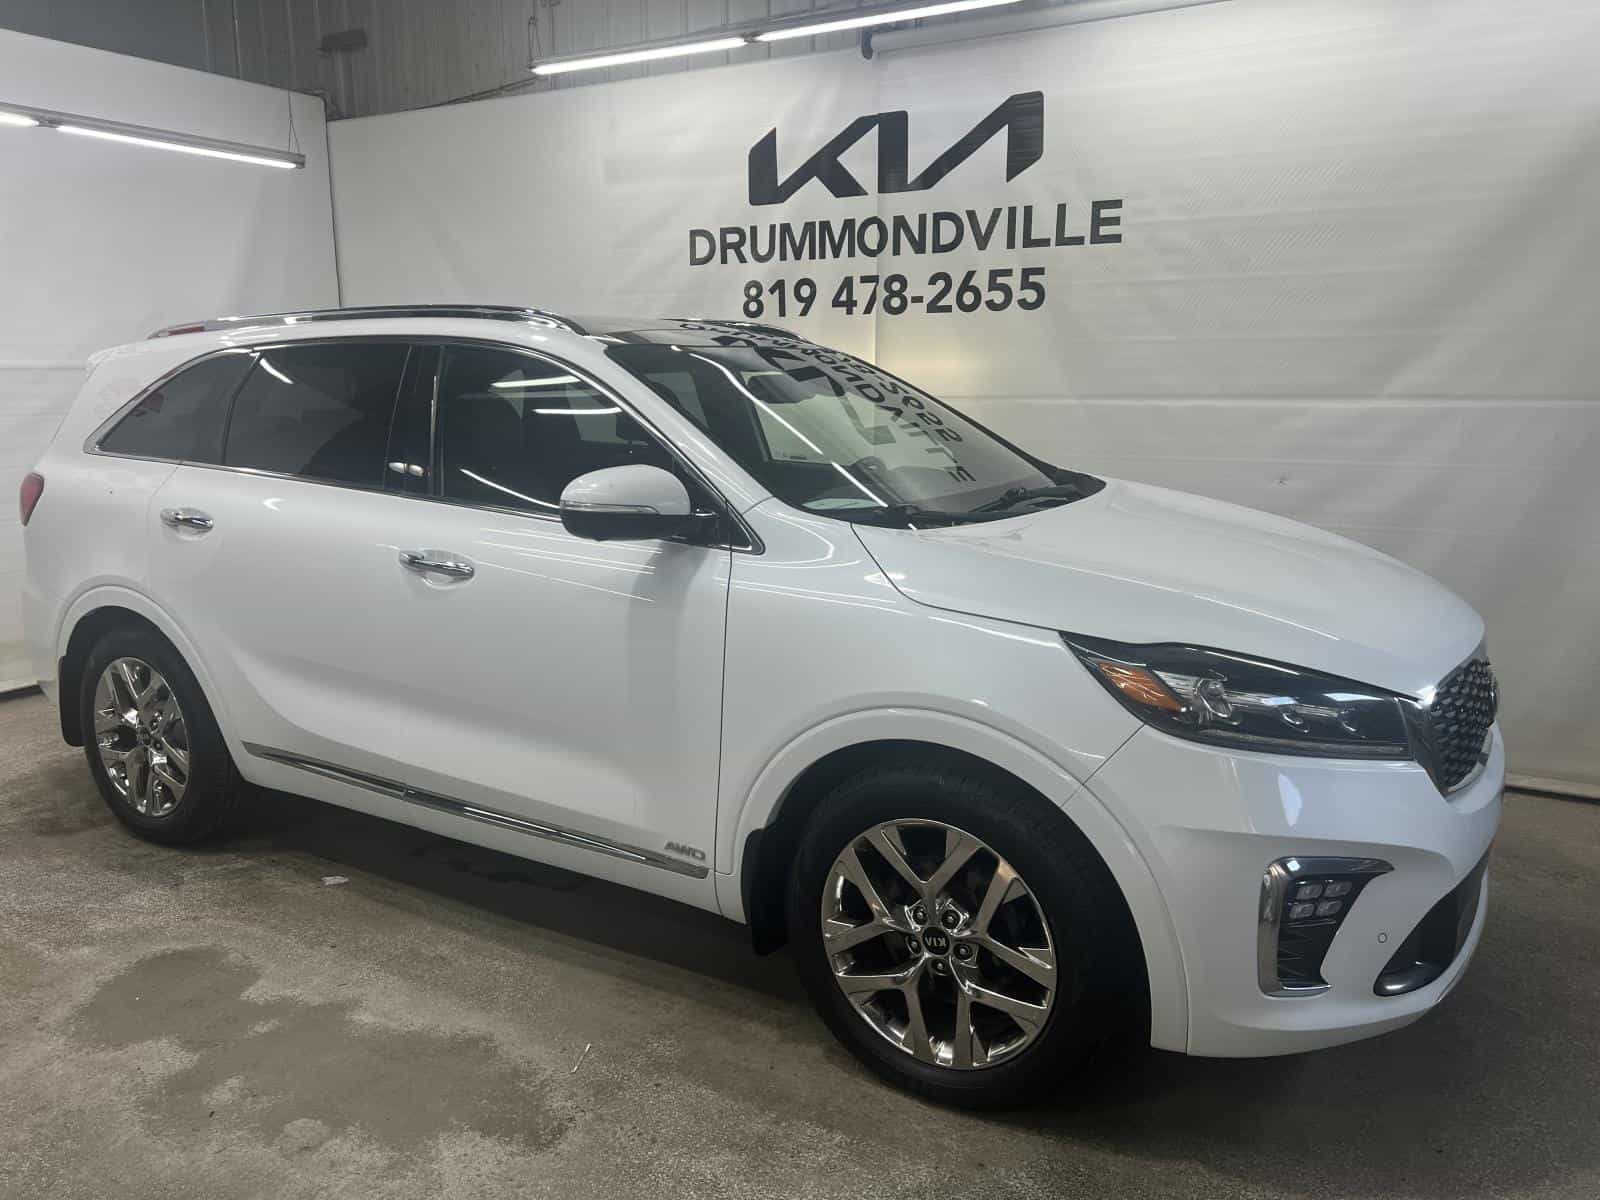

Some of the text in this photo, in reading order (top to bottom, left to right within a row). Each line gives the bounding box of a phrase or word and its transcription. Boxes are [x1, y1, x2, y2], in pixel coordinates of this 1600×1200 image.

[749, 91, 1044, 205] KIA
[689, 200, 1122, 265] DRUMMONDVILLE
[743, 268, 1046, 318] 819 478-2655
[664, 841, 706, 860] AWD
[925, 937, 947, 947] KIA
